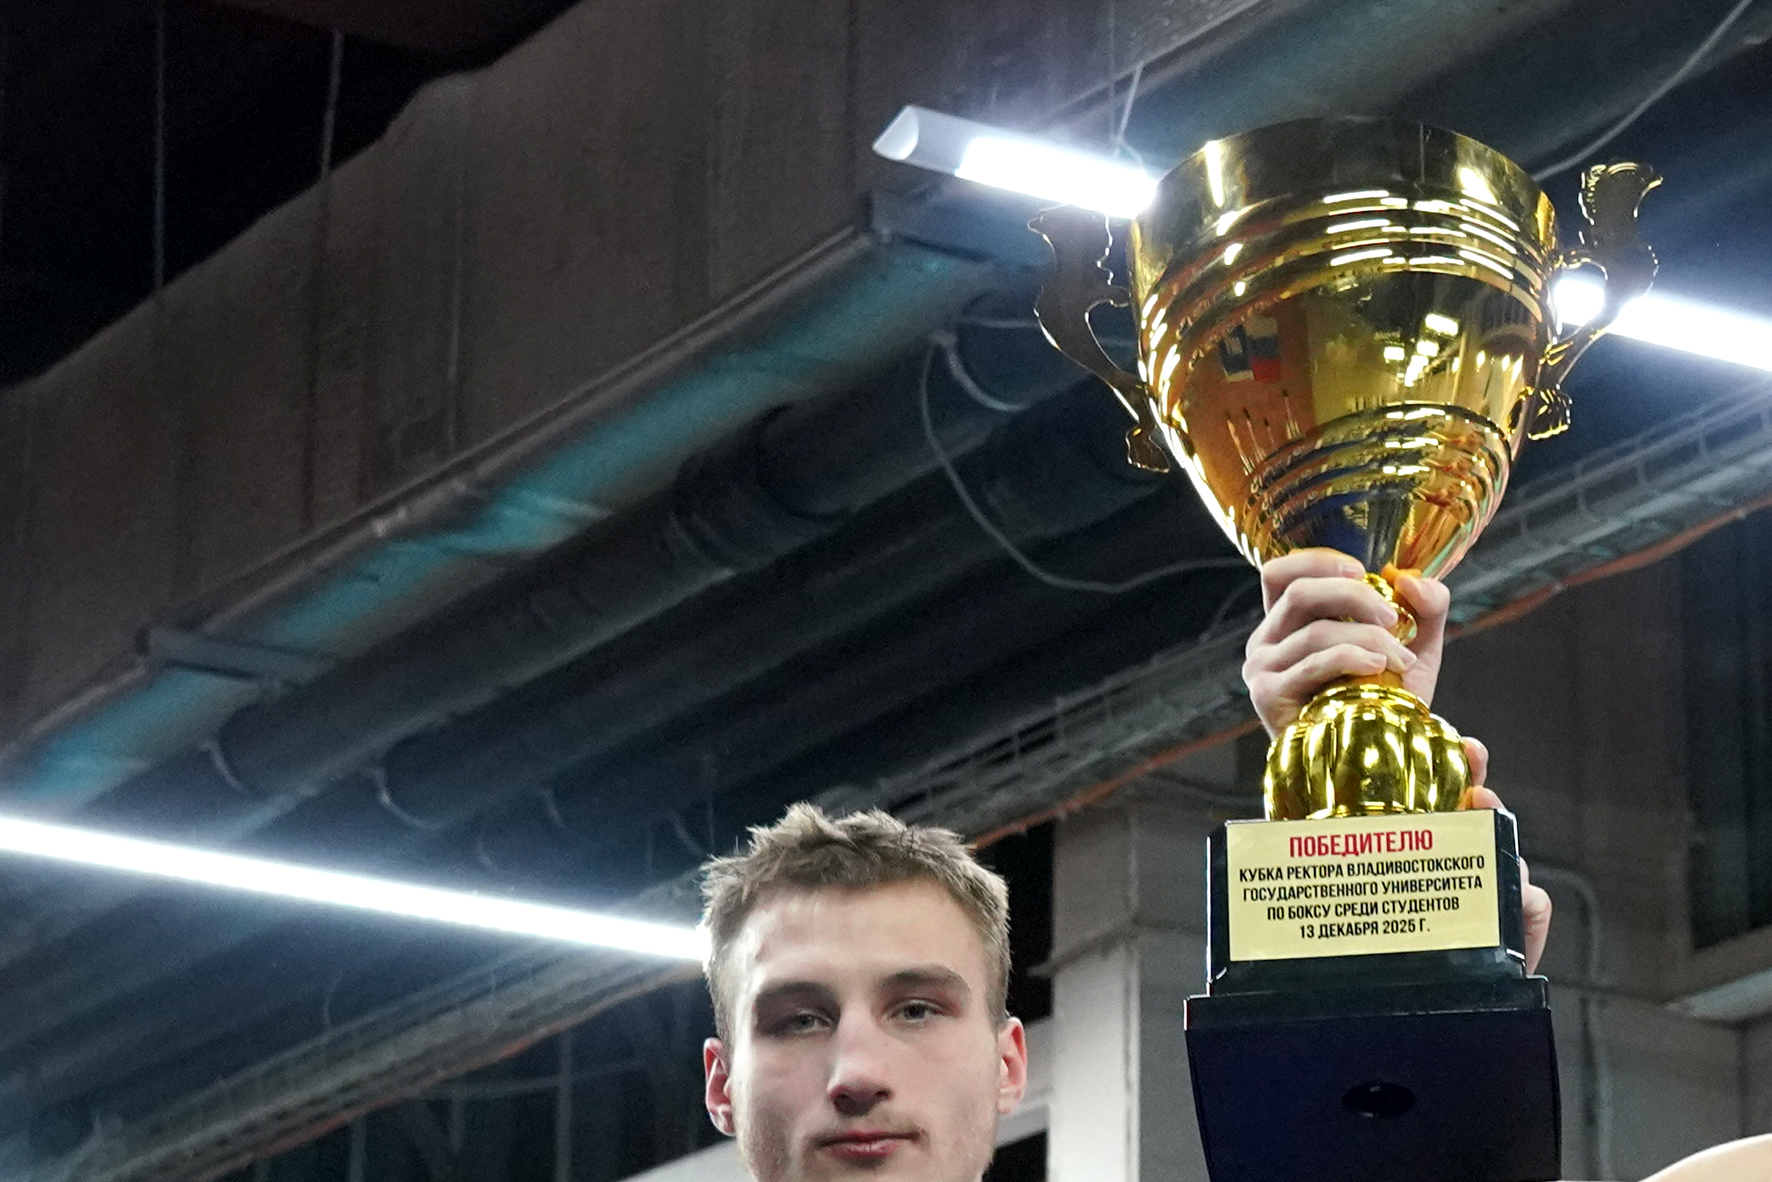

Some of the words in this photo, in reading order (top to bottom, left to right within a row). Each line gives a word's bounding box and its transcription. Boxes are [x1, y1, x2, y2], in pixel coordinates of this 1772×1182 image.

[1289, 829, 1433, 858] ПОБЕДИТЕЛЮ
[1239, 867, 1284, 883] КУБКА
[1287, 864, 1344, 880] РЕКТОРА
[1347, 855, 1485, 877] ВЛАДИВОСТОКСКОГО
[1243, 881, 1378, 902] ГОСУДАРСТВЕННОГО
[1381, 875, 1483, 895] УНИВЕРСИТЕТА
[1267, 906, 1285, 921] ПО
[1288, 904, 1331, 920] БОКСУ
[1334, 901, 1379, 918] СРЕДИ
[1382, 896, 1460, 915] СТУДЕНТОВ
[1300, 924, 1315, 939] 13
[1318, 921, 1379, 939] ДЕКАБРЯ
[1382, 918, 1416, 934] 2025
[1419, 918, 1431, 933] Г.
